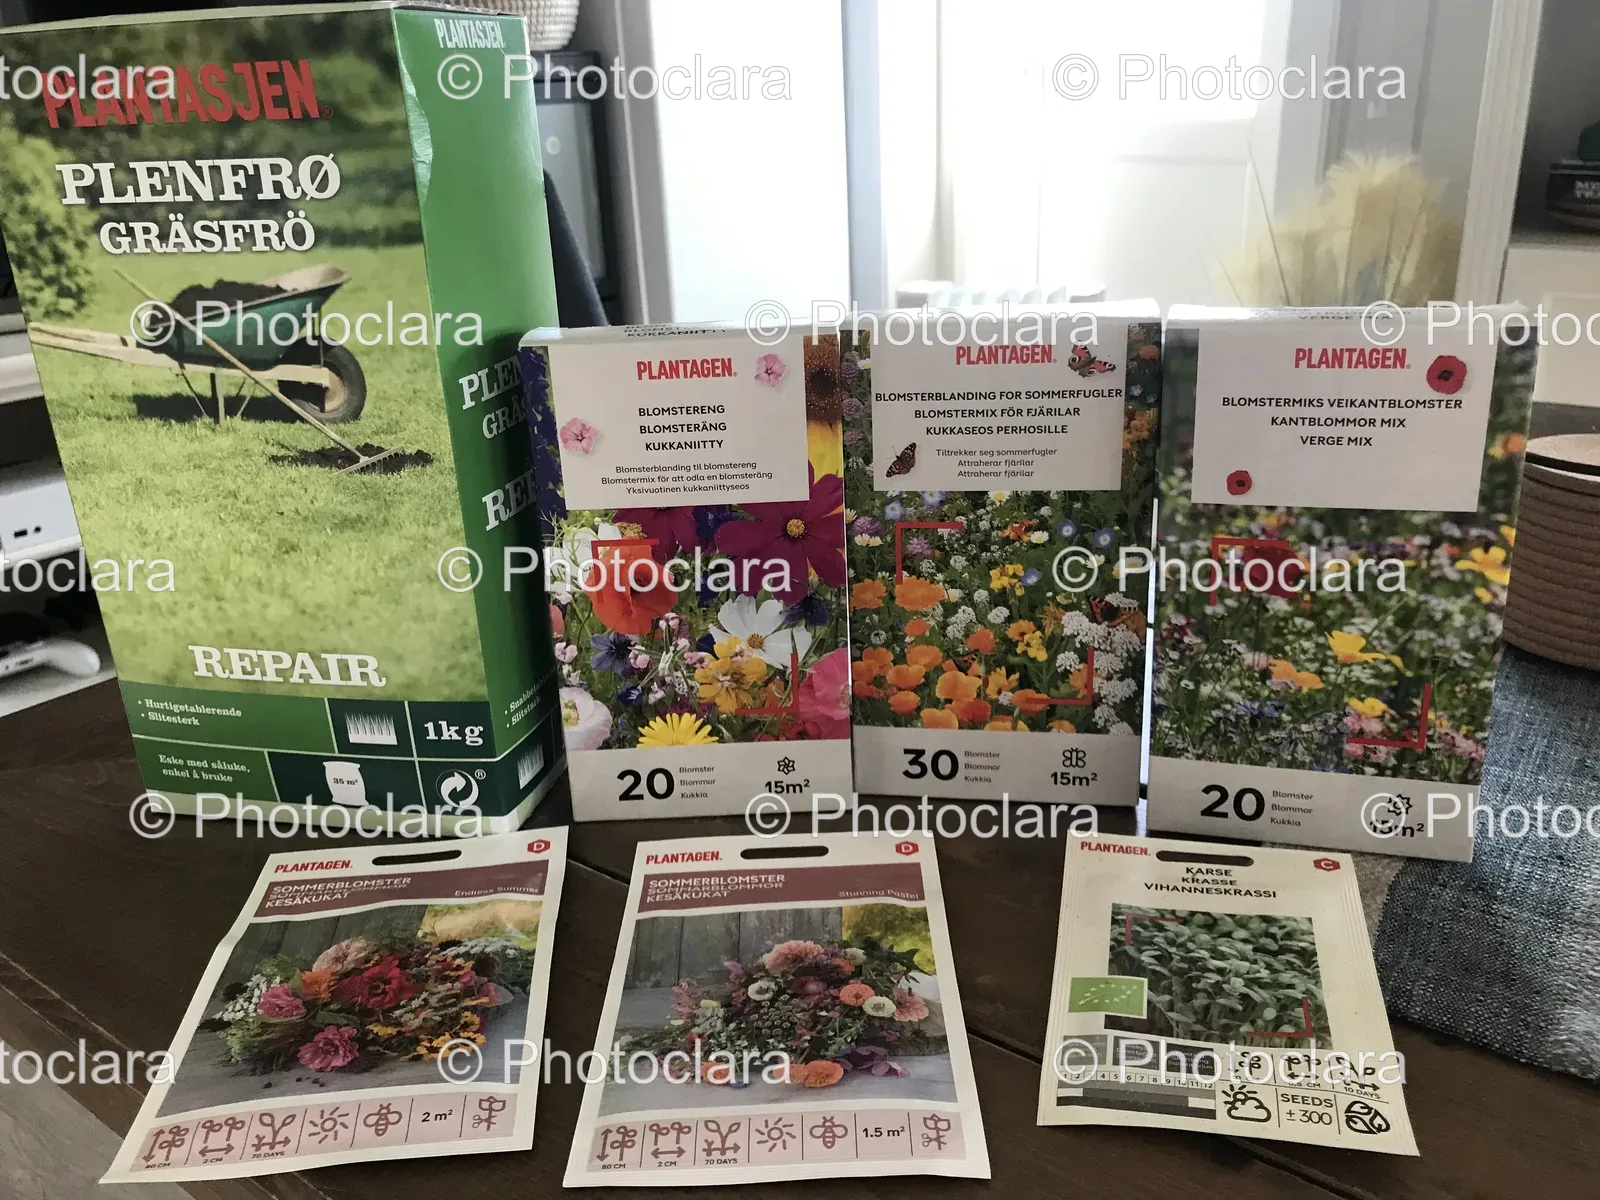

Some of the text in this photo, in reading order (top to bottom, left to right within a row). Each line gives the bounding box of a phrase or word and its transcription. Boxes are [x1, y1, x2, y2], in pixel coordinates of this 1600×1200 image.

[434, 18, 504, 49] PLANTASJEN
[56, 153, 341, 206] PLENFRØ
[99, 210, 316, 254] GRÄSFRÖ
[956, 344, 1053, 365] PLANTAGEN
[1295, 347, 1407, 369] PLANTAGEN
[636, 357, 734, 380] PLANTAGEN
[875, 388, 1123, 402] BLOMSTERBLANDING FOR SOMMERFUGLER
[1222, 396, 1463, 410] BLOMSTERMIKS VEIKANTBLOMSTER
[638, 404, 726, 417] BLOMSTERENG
[914, 405, 1081, 419] BLOMSTERMIX FÖR FJÄRILAR
[639, 419, 727, 434] BLOMSTERÄNG
[1270, 416, 1406, 428] KANTBLOMMOR MIX
[926, 424, 1068, 436] KUKKASEOS PERHOSILLE
[645, 439, 724, 451] KUKKANIITTY
[1300, 435, 1373, 447] VERGE MIX
[936, 448, 1058, 459] Tiltrekker seg sommerfugler
[615, 460, 757, 474] Blomsterblanding til blomstereng
[957, 458, 1035, 468] Attraherar fjärilar
[601, 474, 656, 485] Blomstermix
[657, 474, 669, 483] för
[671, 474, 684, 482] att
[686, 473, 704, 482] odla
[719, 471, 773, 483] blomsteräng
[957, 469, 1035, 479] Attraherar fjärilar
[626, 482, 750, 495] Yksivuotinen kukkaniittyseos
[188, 644, 388, 688] REPAIR
[144, 698, 242, 718] Hurtigetablerende
[148, 711, 201, 726] Slitesterk
[964, 750, 1001, 759] Blomster
[158, 753, 250, 773] Eske med såluke,
[679, 765, 715, 774] Blomster
[902, 748, 959, 781] 30
[964, 762, 1001, 771] Blommor
[162, 766, 233, 783] enkel å bruke
[964, 774, 992, 783] Kukkia
[616, 767, 675, 802] 20
[680, 778, 716, 787] Blommor
[680, 791, 708, 799] Kukkia
[1272, 789, 1314, 801] Blomster
[1200, 784, 1266, 822] 20
[1271, 803, 1313, 815] Blommor
[1270, 816, 1301, 827] Kukkia
[531, 841, 545, 852] D
[901, 843, 913, 853] D
[1080, 841, 1150, 856] PLANTAGEN
[645, 851, 720, 865] PLANTAGEN
[1320, 860, 1333, 869] C
[273, 859, 351, 874] PLANTAGEN
[1185, 866, 1233, 877] KARSE
[272, 877, 412, 894] SOMMERBLOMSTER
[649, 873, 786, 889] SOMMERBLOMSTER
[1181, 876, 1238, 887] KRASSE
[648, 882, 784, 895] SOMMARBLOMMOR
[838, 889, 919, 899] Stunning Pastel
[1144, 882, 1278, 898] VIHANNESKRASSI
[1281, 1093, 1334, 1108] SEEDS
[1356, 1088, 1381, 1100] DAYS
[421, 1108, 453, 1123] 2 m²
[862, 1125, 905, 1138] 1.5 m²
